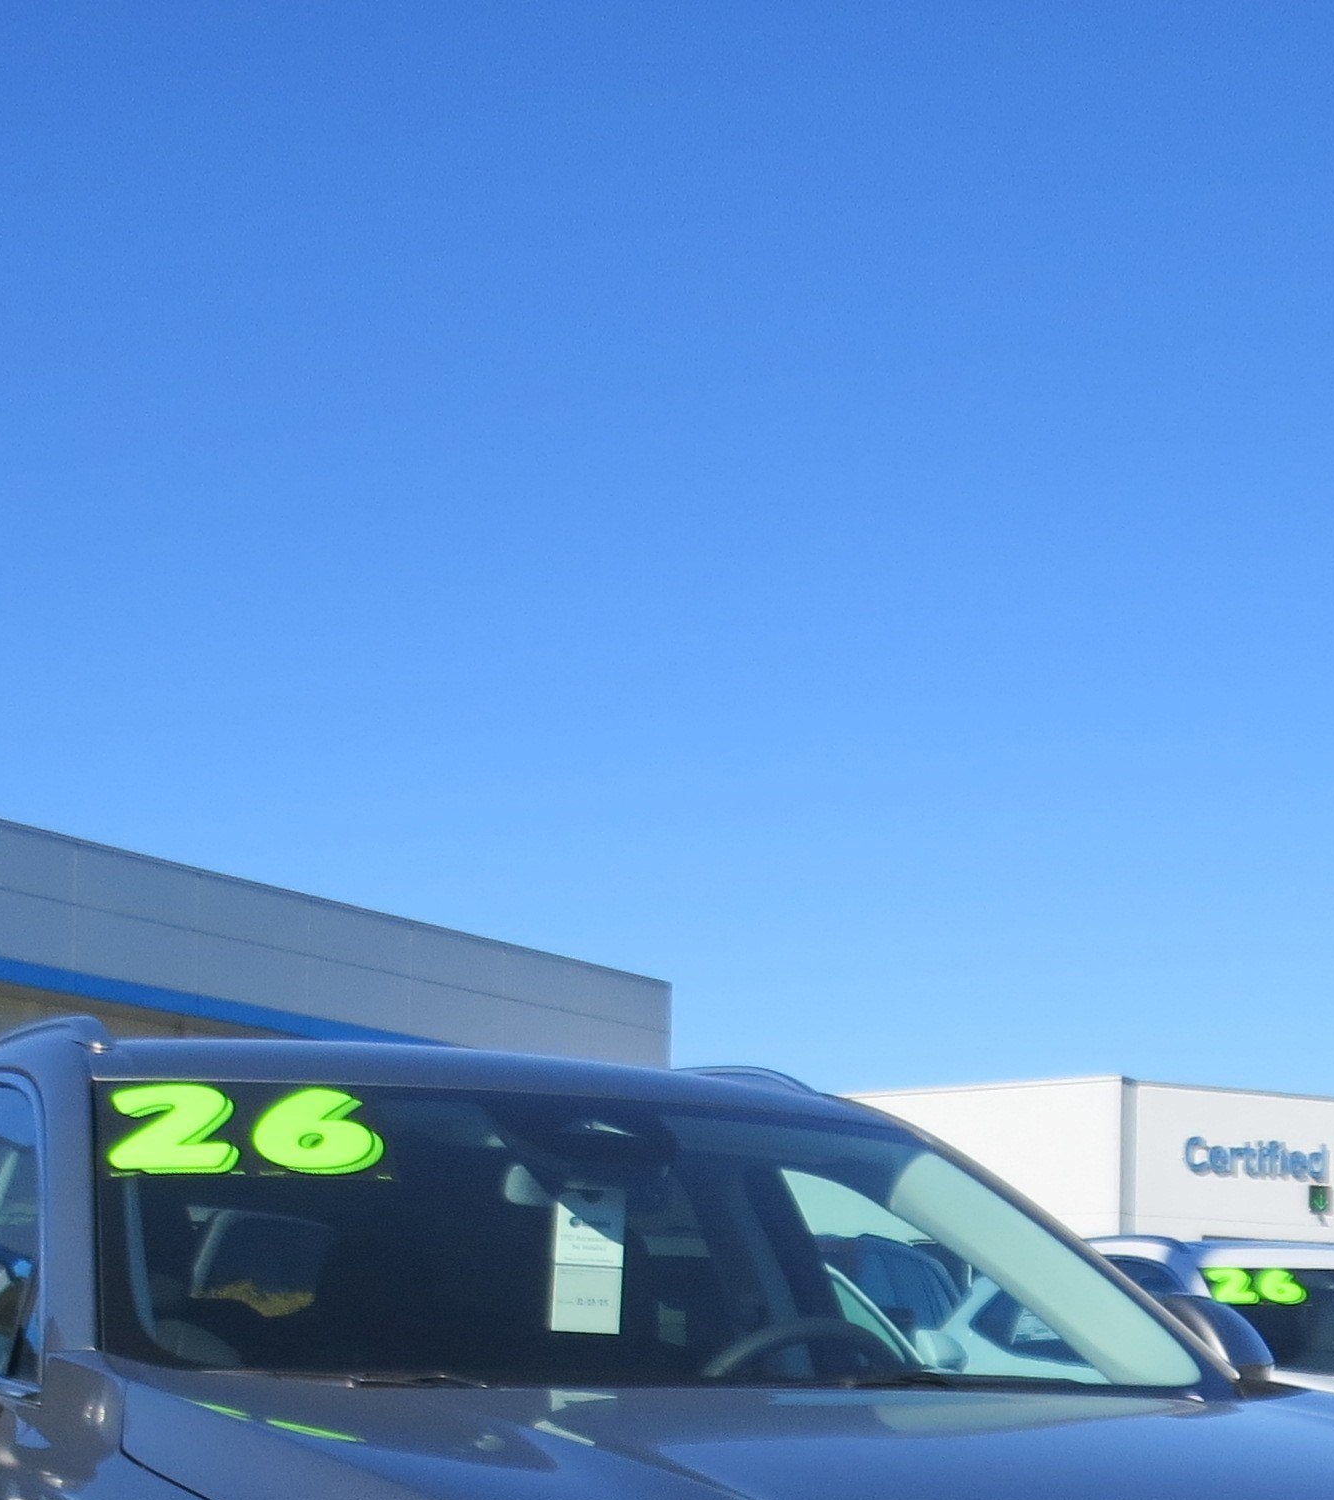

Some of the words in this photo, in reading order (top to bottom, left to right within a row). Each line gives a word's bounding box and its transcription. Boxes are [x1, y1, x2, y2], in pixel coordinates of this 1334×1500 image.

[107, 1082, 385, 1175] 26
[1183, 1136, 1329, 1182] Certified
[1203, 1267, 1308, 1305] 26
